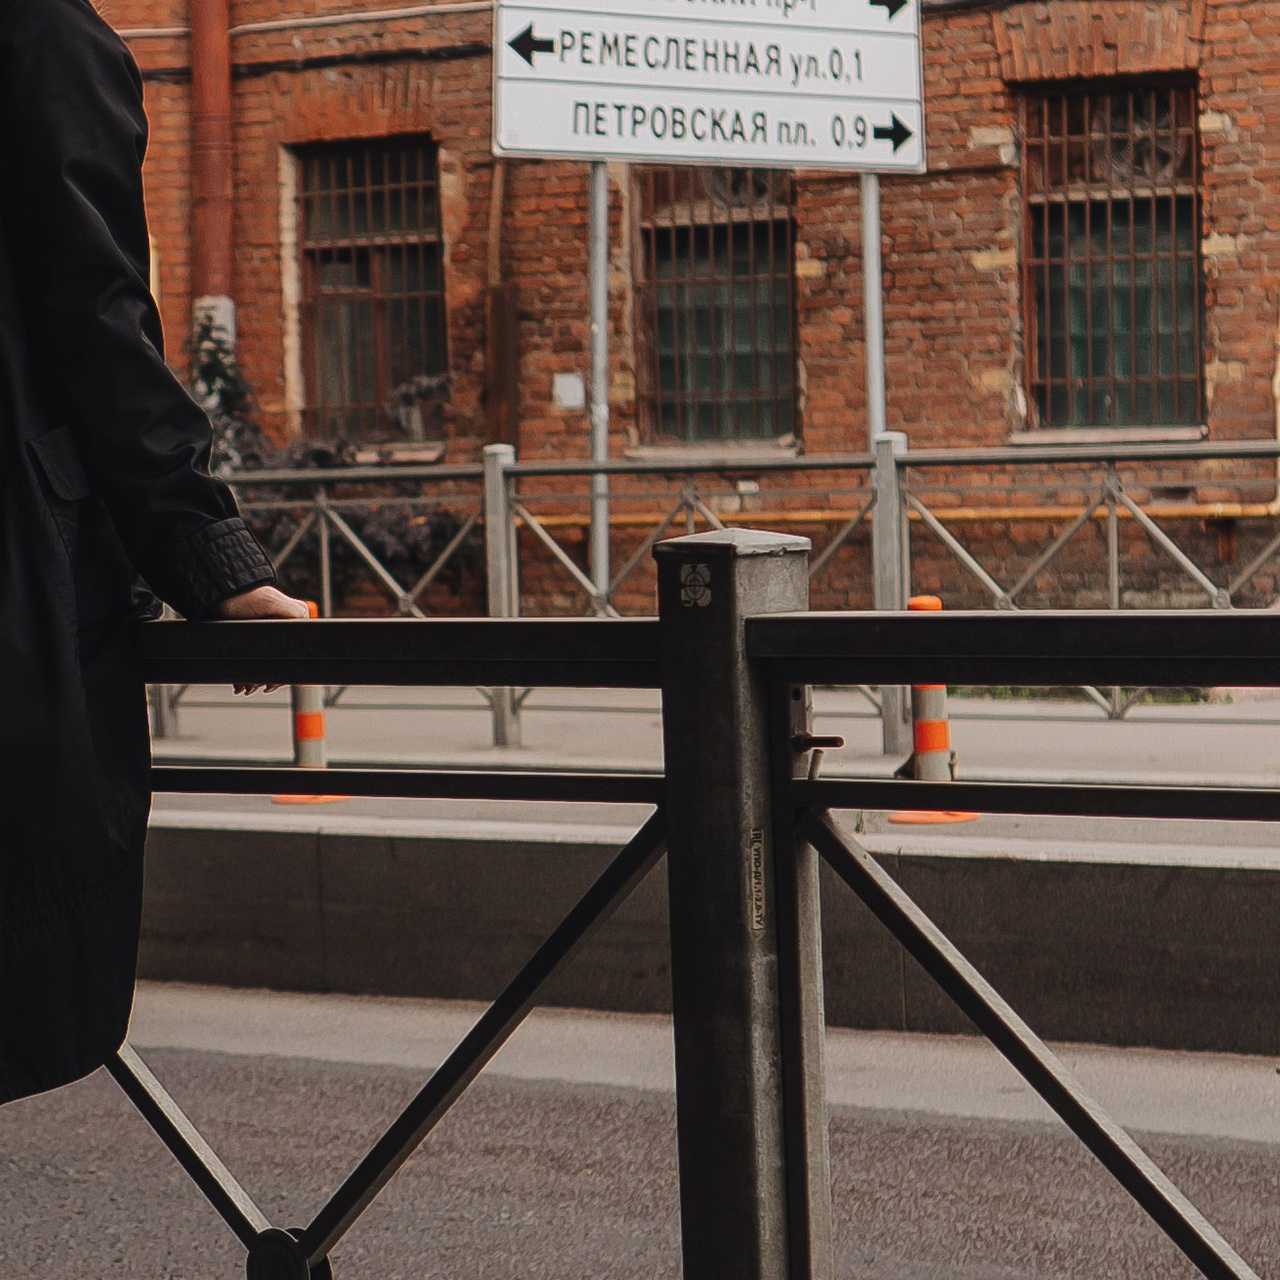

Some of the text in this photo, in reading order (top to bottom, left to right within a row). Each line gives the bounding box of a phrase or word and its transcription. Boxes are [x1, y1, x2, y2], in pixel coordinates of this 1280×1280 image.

[558, 29, 782, 77] РЕМЕСЛЕННАЯ
[572, 101, 768, 145] ПЕТРОВСКАЯ
[777, 120, 817, 147] пл.
